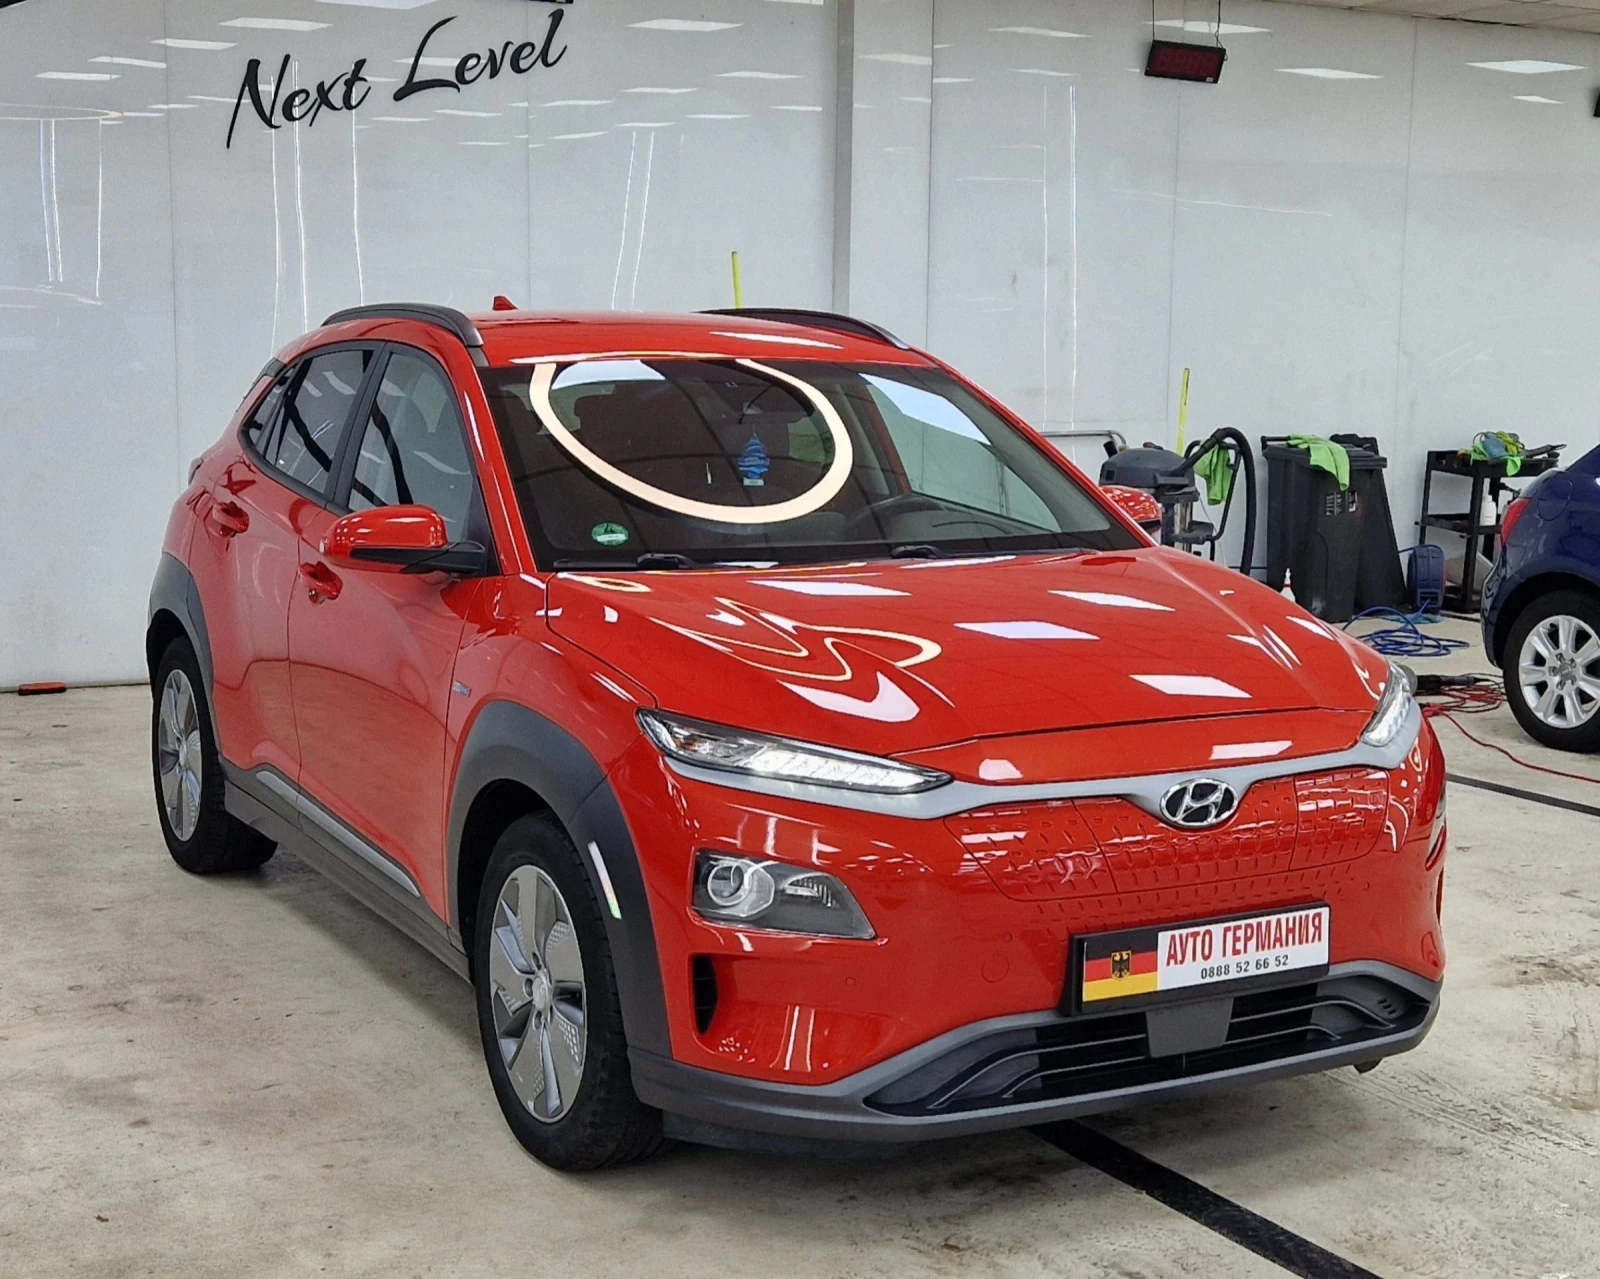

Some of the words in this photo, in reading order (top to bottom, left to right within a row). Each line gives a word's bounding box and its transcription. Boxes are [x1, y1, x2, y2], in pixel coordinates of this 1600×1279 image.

[226, 54, 371, 149] Next
[392, 8, 568, 102] Level
[1166, 928, 1212, 967] АУТО
[1222, 912, 1323, 958] ГЕРМАНИЯ
[1201, 963, 1230, 980] 0888
[1236, 960, 1250, 974] 52
[1255, 957, 1269, 971] 66
[1275, 954, 1289, 967] 52
